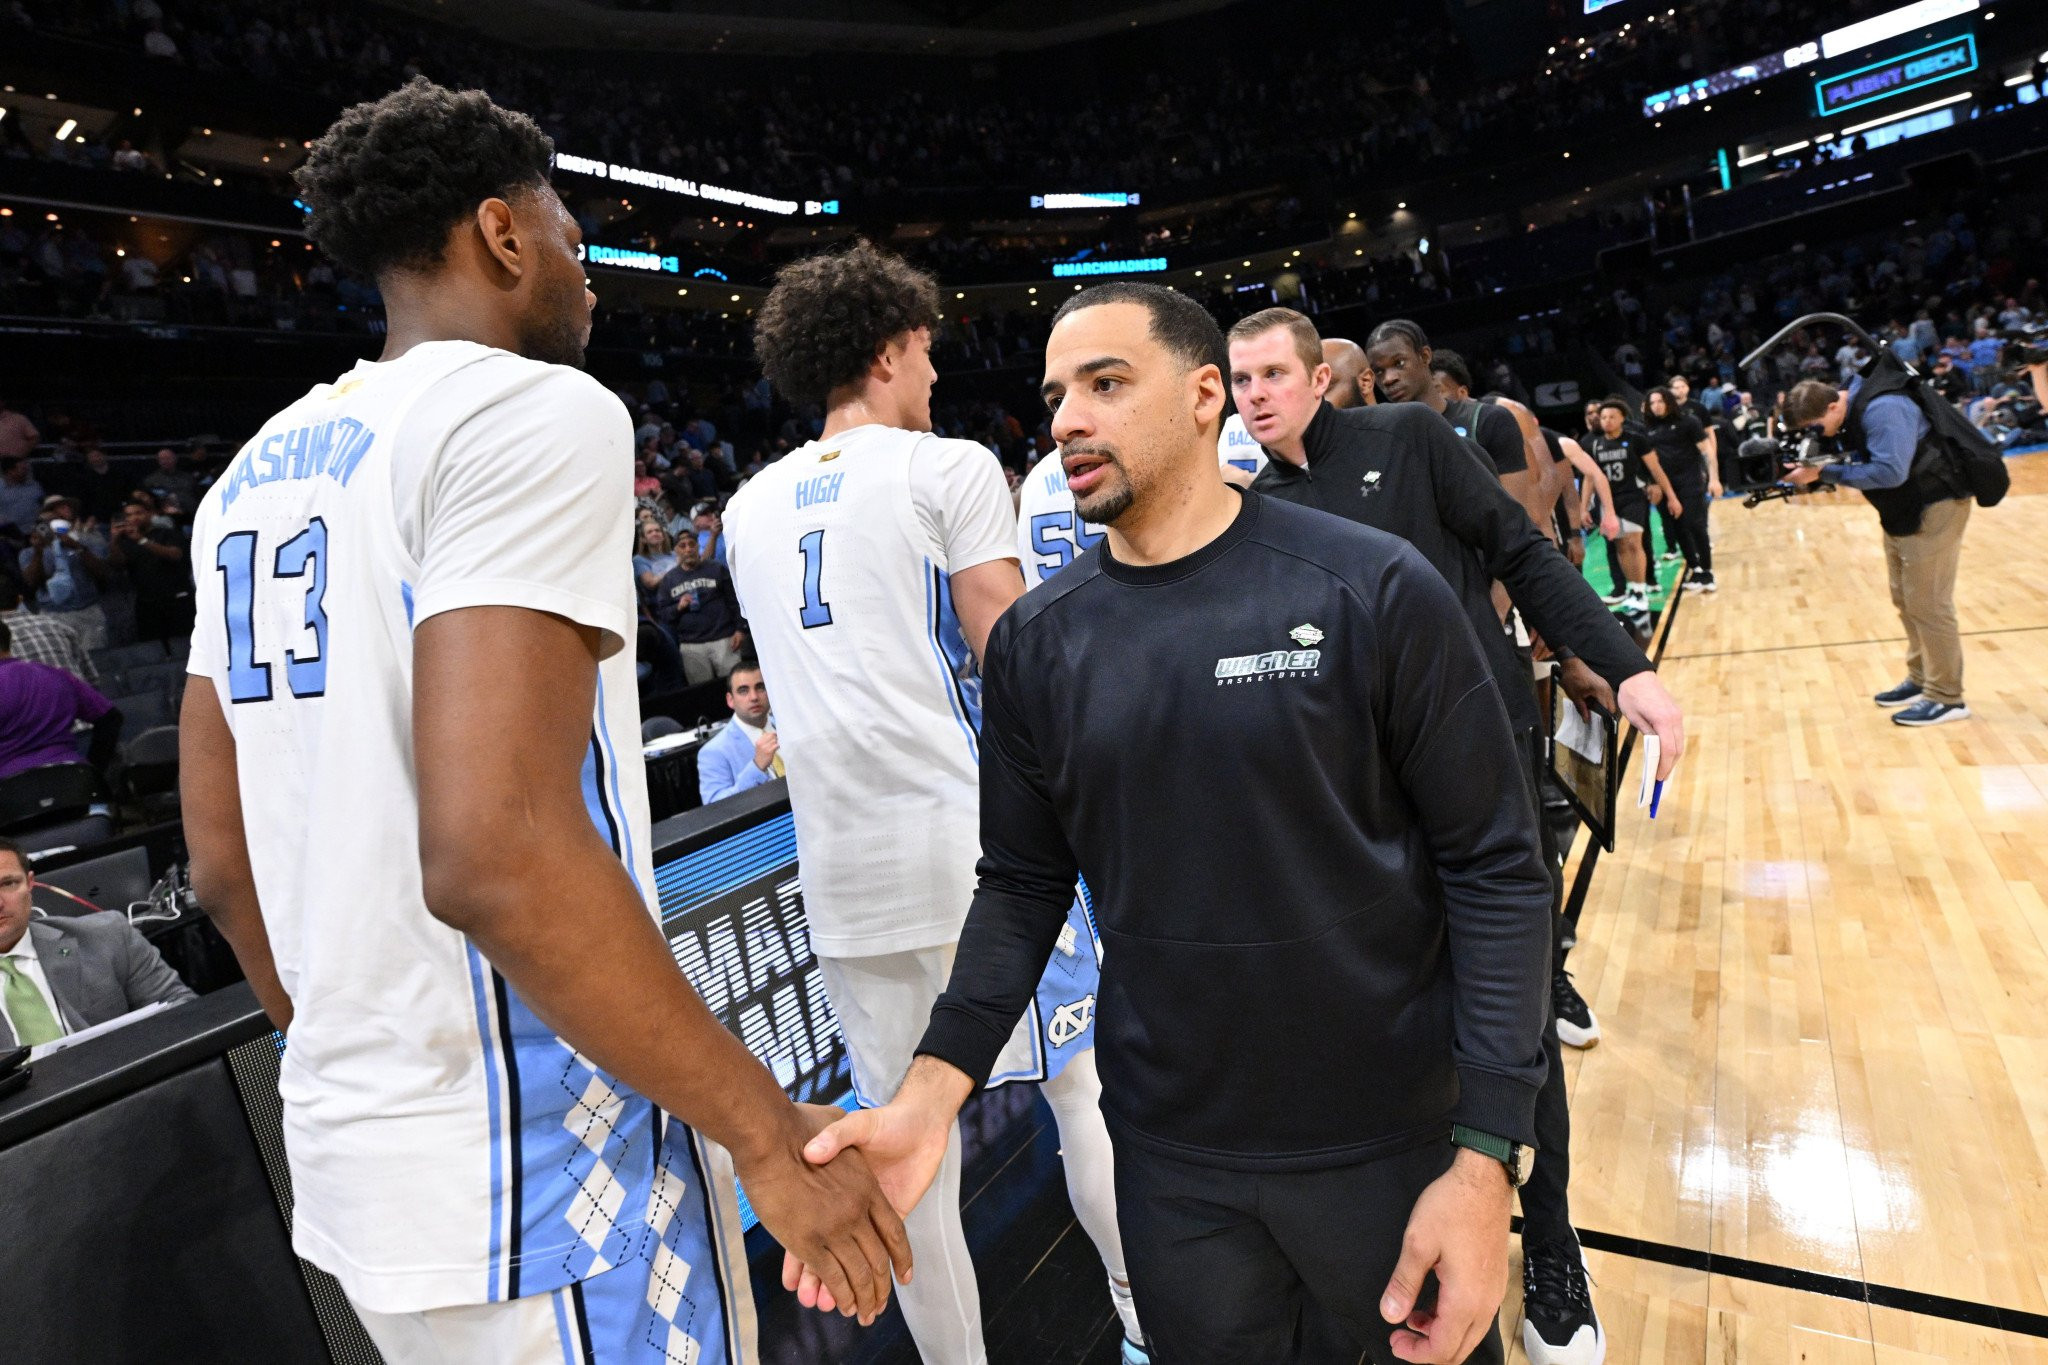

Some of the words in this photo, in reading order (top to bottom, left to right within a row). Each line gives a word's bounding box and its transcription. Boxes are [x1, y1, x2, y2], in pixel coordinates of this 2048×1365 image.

[1826, 66, 1902, 104] FLIGHT
[1904, 46, 1966, 81] DECK
[556, 153, 607, 177] MEN'S
[609, 164, 699, 197] BASKETBALL
[589, 245, 661, 271] ROUNDS
[1053, 257, 1167, 278] #MARCHMADNESS
[1604, 462, 1624, 482] 13
[796, 472, 845, 510] HIGH
[799, 529, 833, 630] 1
[216, 515, 328, 704] 13
[1215, 649, 1321, 678] WAGNER
[1217, 670, 1320, 686] BASKETBALL
